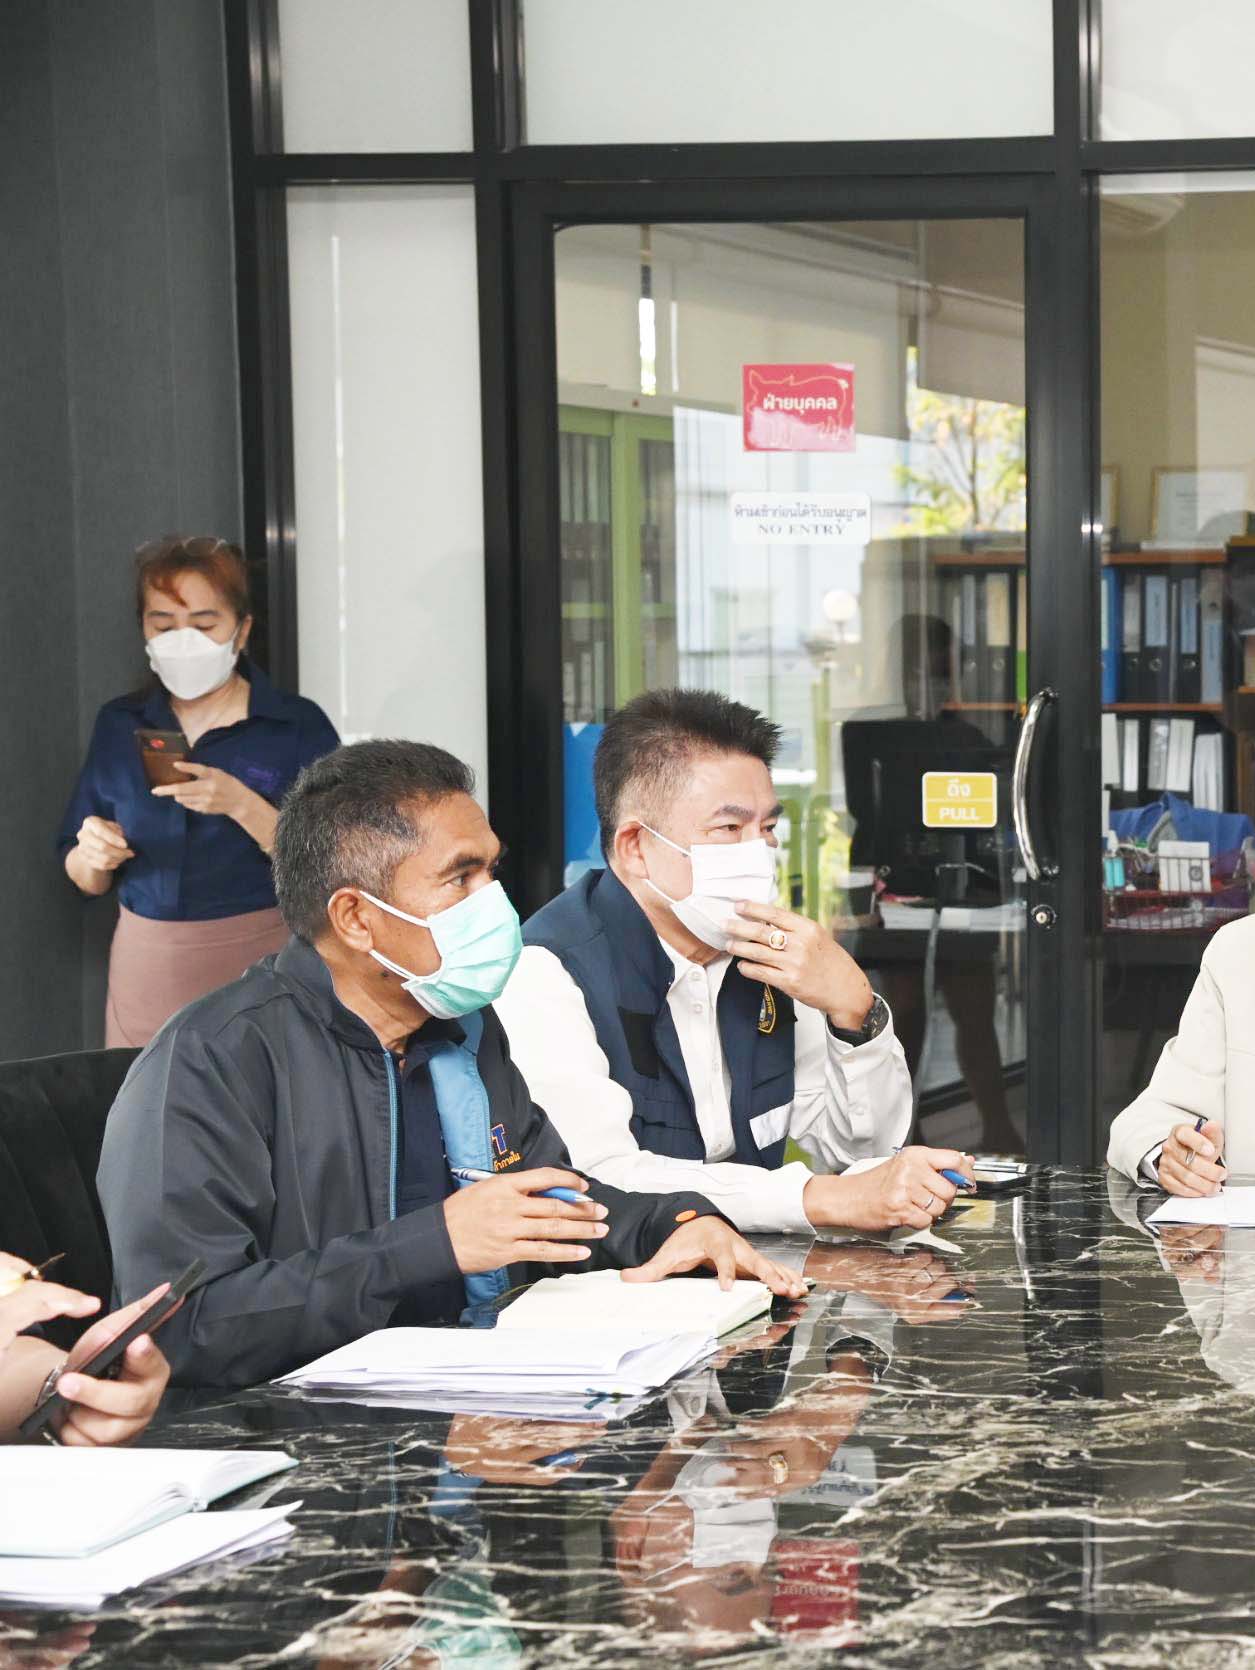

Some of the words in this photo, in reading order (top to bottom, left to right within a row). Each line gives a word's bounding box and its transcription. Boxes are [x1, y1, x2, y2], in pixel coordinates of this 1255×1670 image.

[763, 393, 838, 415] ฝ่ายบุคคล
[758, 524, 782, 536] NO
[789, 524, 846, 536] ENTRY
[946, 777, 972, 798] ดึง
[939, 807, 982, 821] PULL
